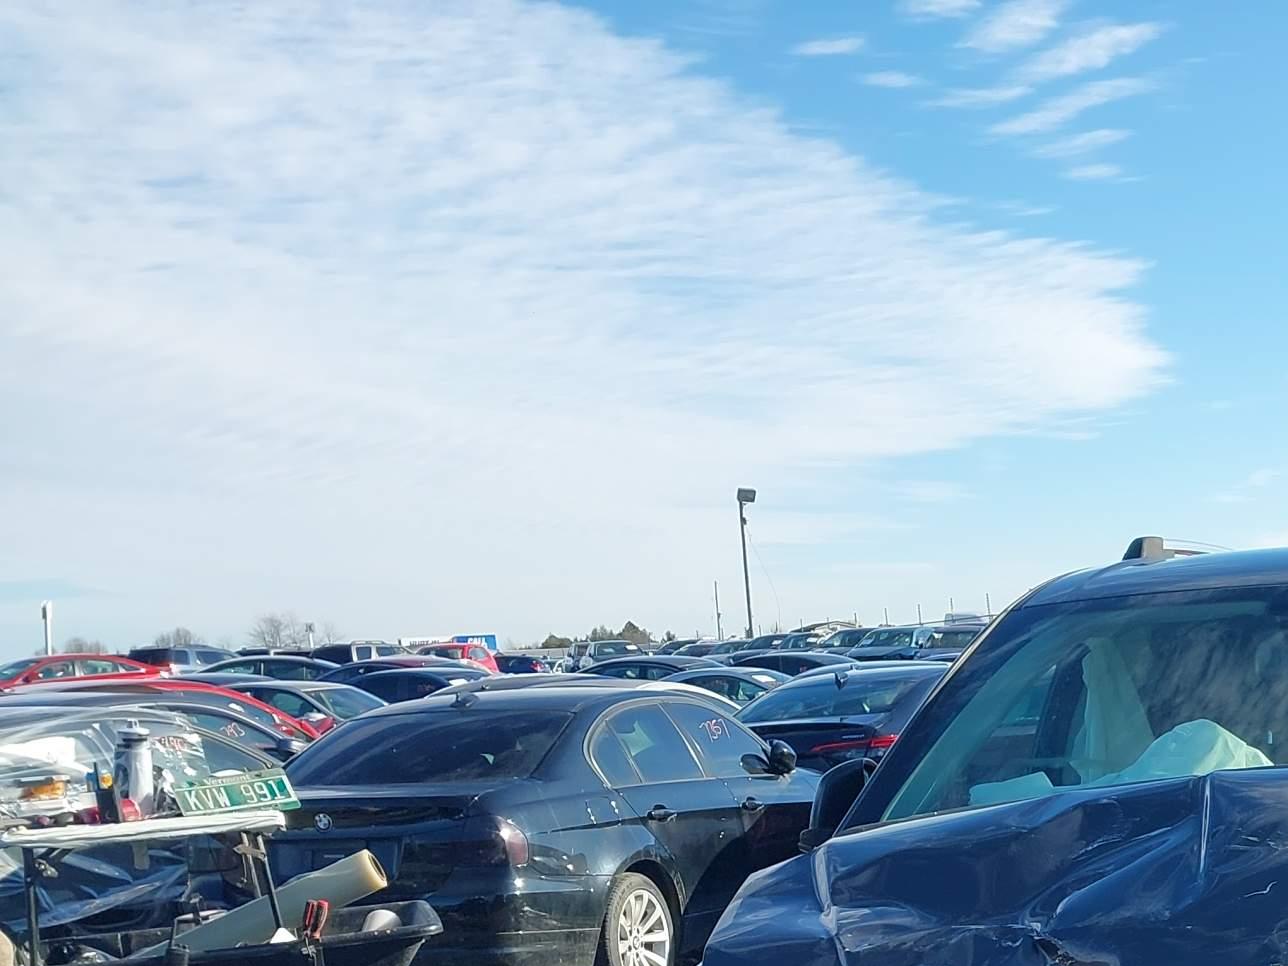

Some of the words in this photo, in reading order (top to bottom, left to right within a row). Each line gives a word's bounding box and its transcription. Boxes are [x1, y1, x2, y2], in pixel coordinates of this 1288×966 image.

[203, 774, 250, 786] Vermont
[184, 786, 231, 811] KVW
[241, 778, 286, 803] 991
